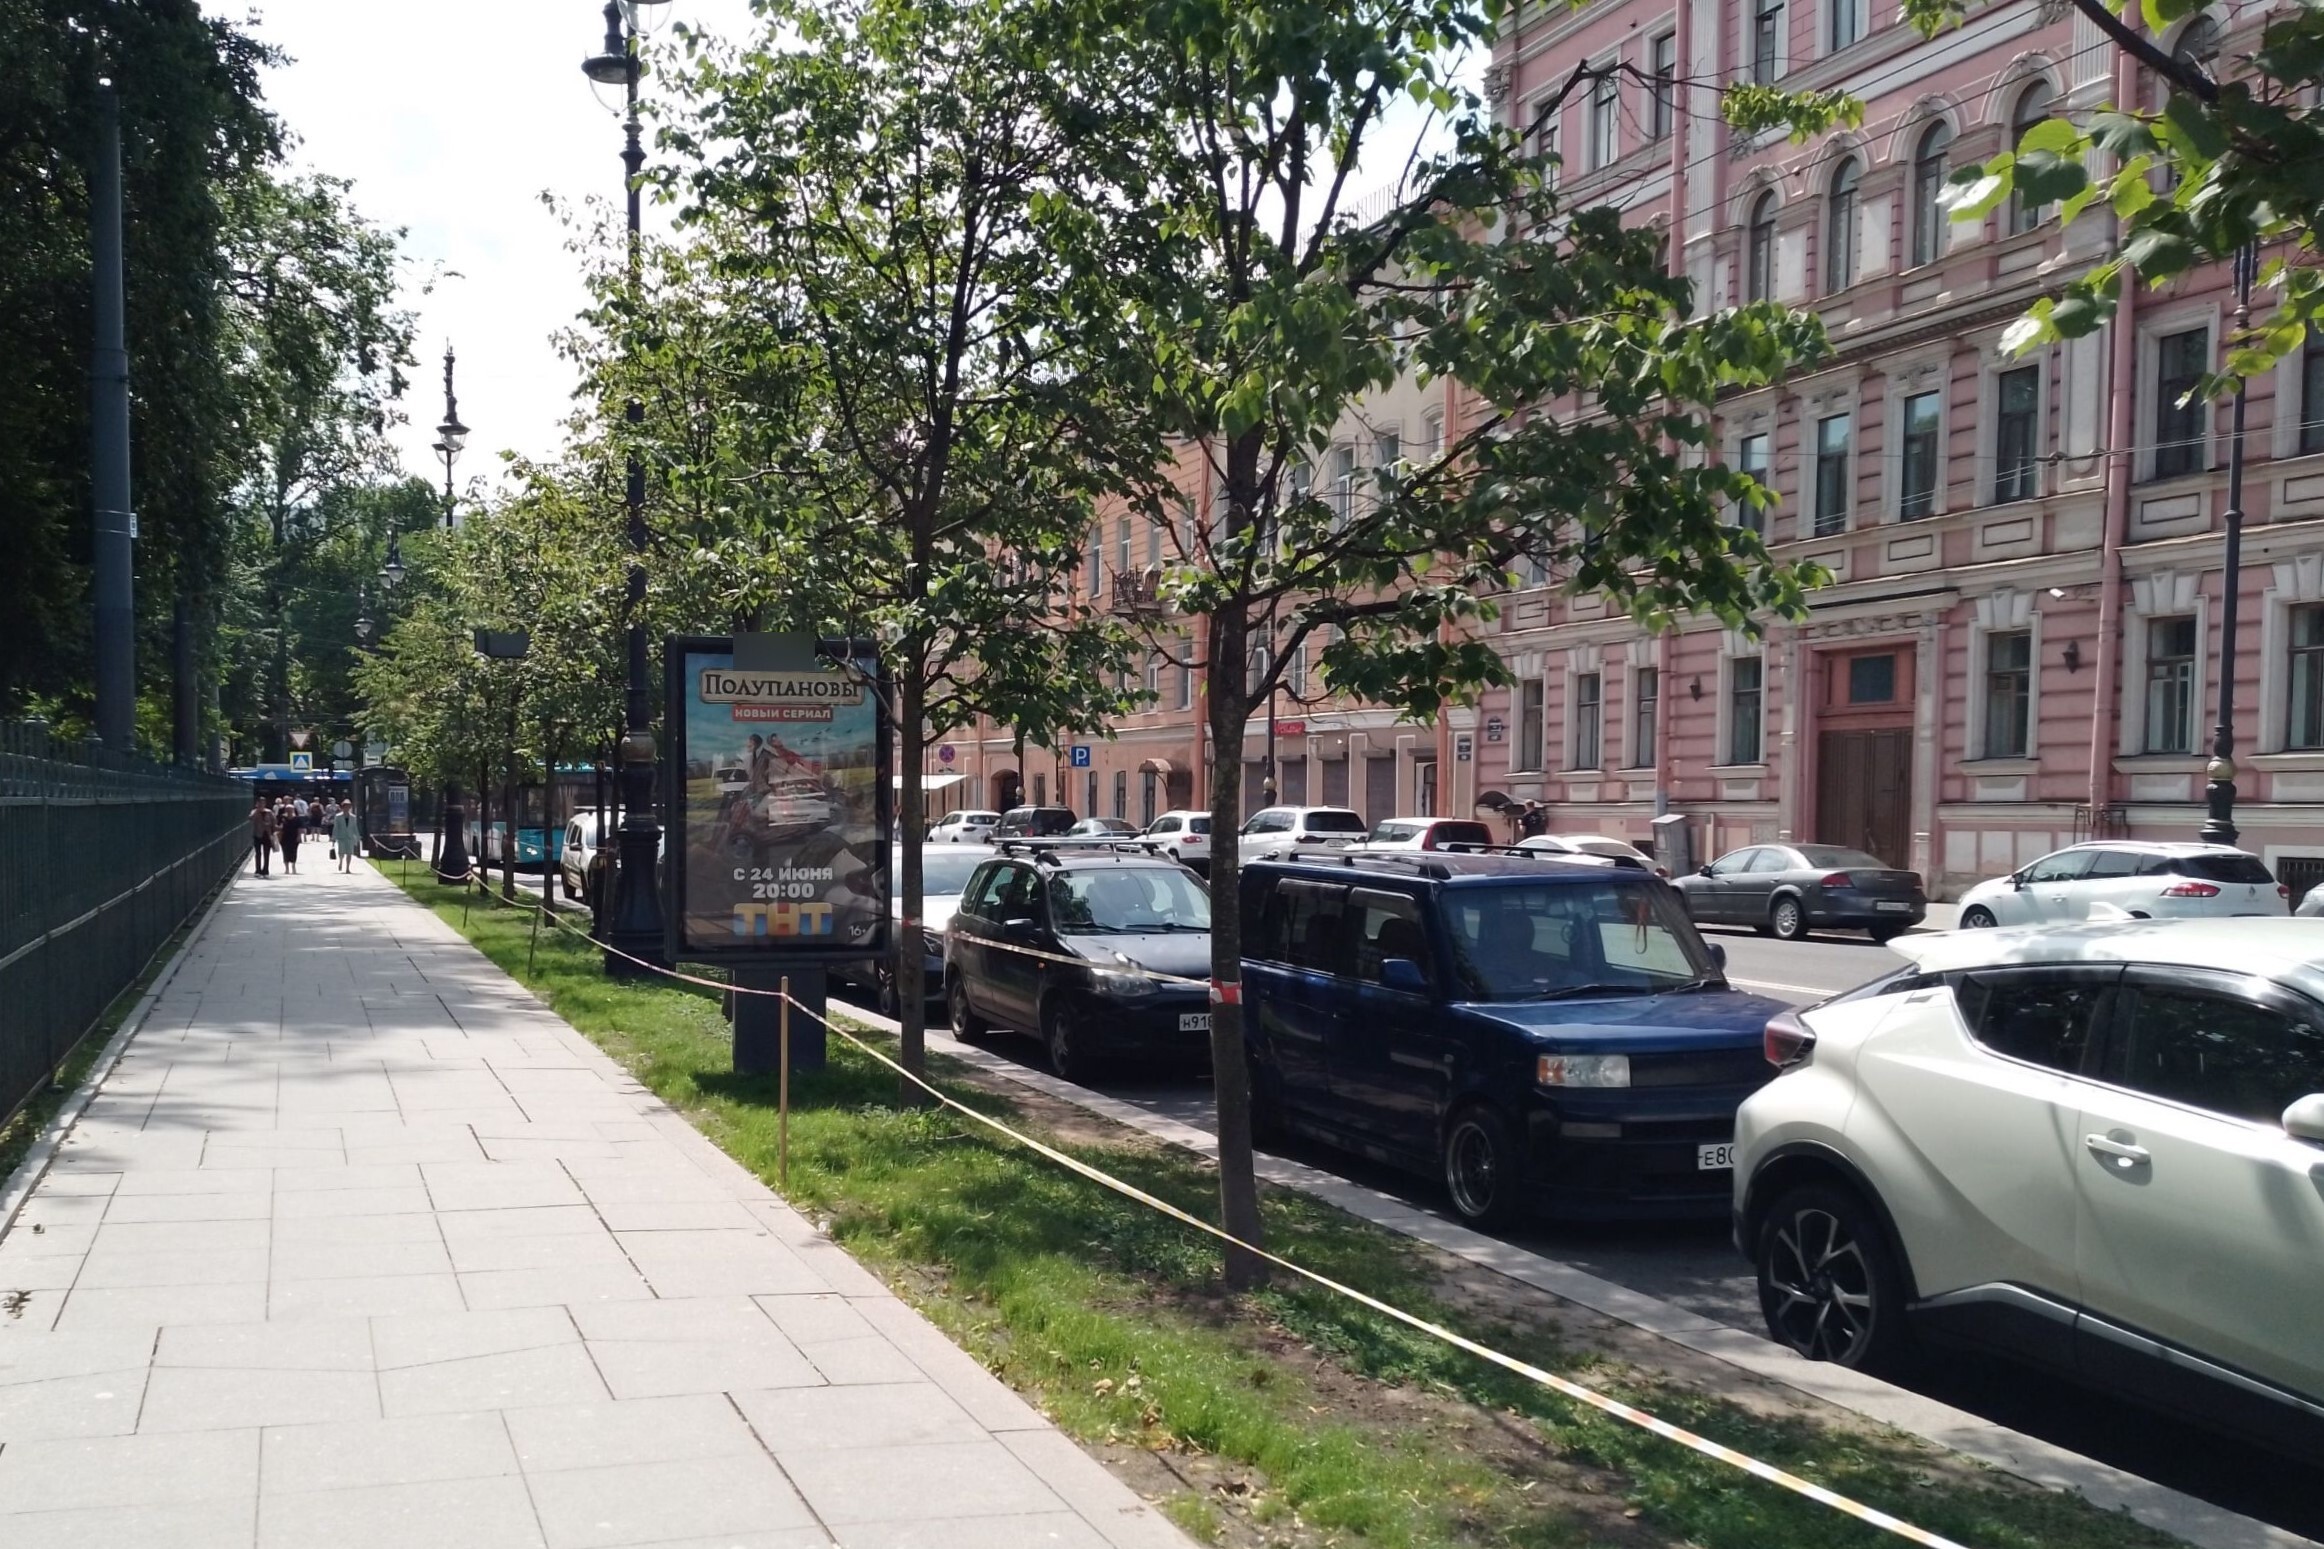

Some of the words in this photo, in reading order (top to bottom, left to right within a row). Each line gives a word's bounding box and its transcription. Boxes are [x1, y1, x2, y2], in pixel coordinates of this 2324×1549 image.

[783, 709, 831, 719] СЕРИАЛ
[1076, 747, 1087, 765] P
[750, 867, 773, 881] 24
[779, 867, 833, 881] ИЮНЯ
[752, 882, 815, 899] 20:00
[733, 902, 833, 936] ТНТ
